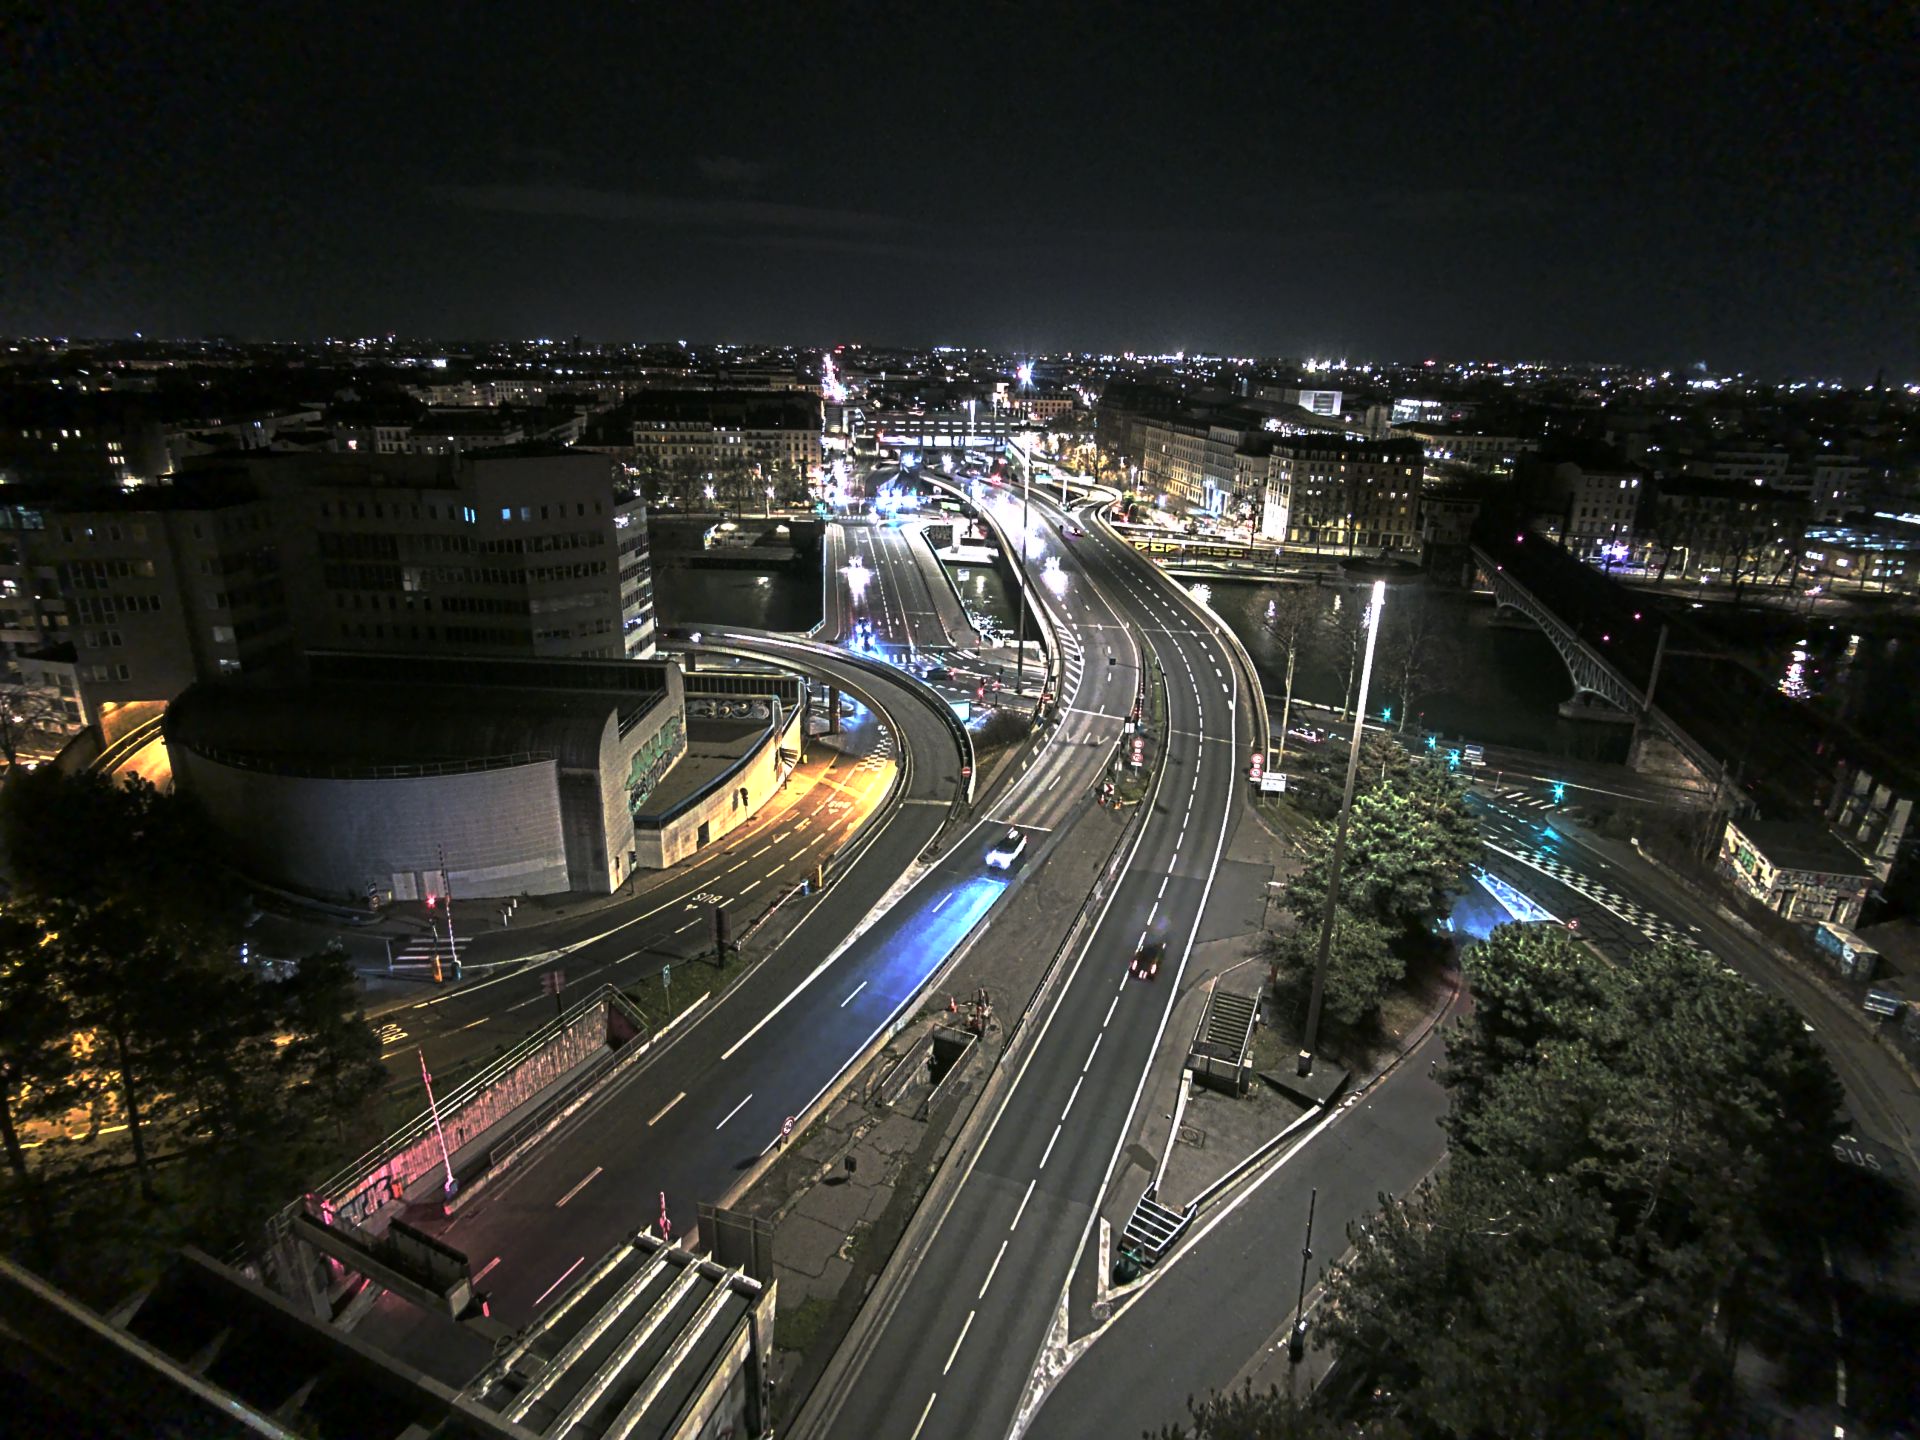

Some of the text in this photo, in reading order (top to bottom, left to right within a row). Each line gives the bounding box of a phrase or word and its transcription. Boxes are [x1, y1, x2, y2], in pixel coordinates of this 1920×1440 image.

[692, 892, 723, 903] BUS
[381, 1023, 408, 1044] BUS
[1831, 1144, 1881, 1170] BUS
